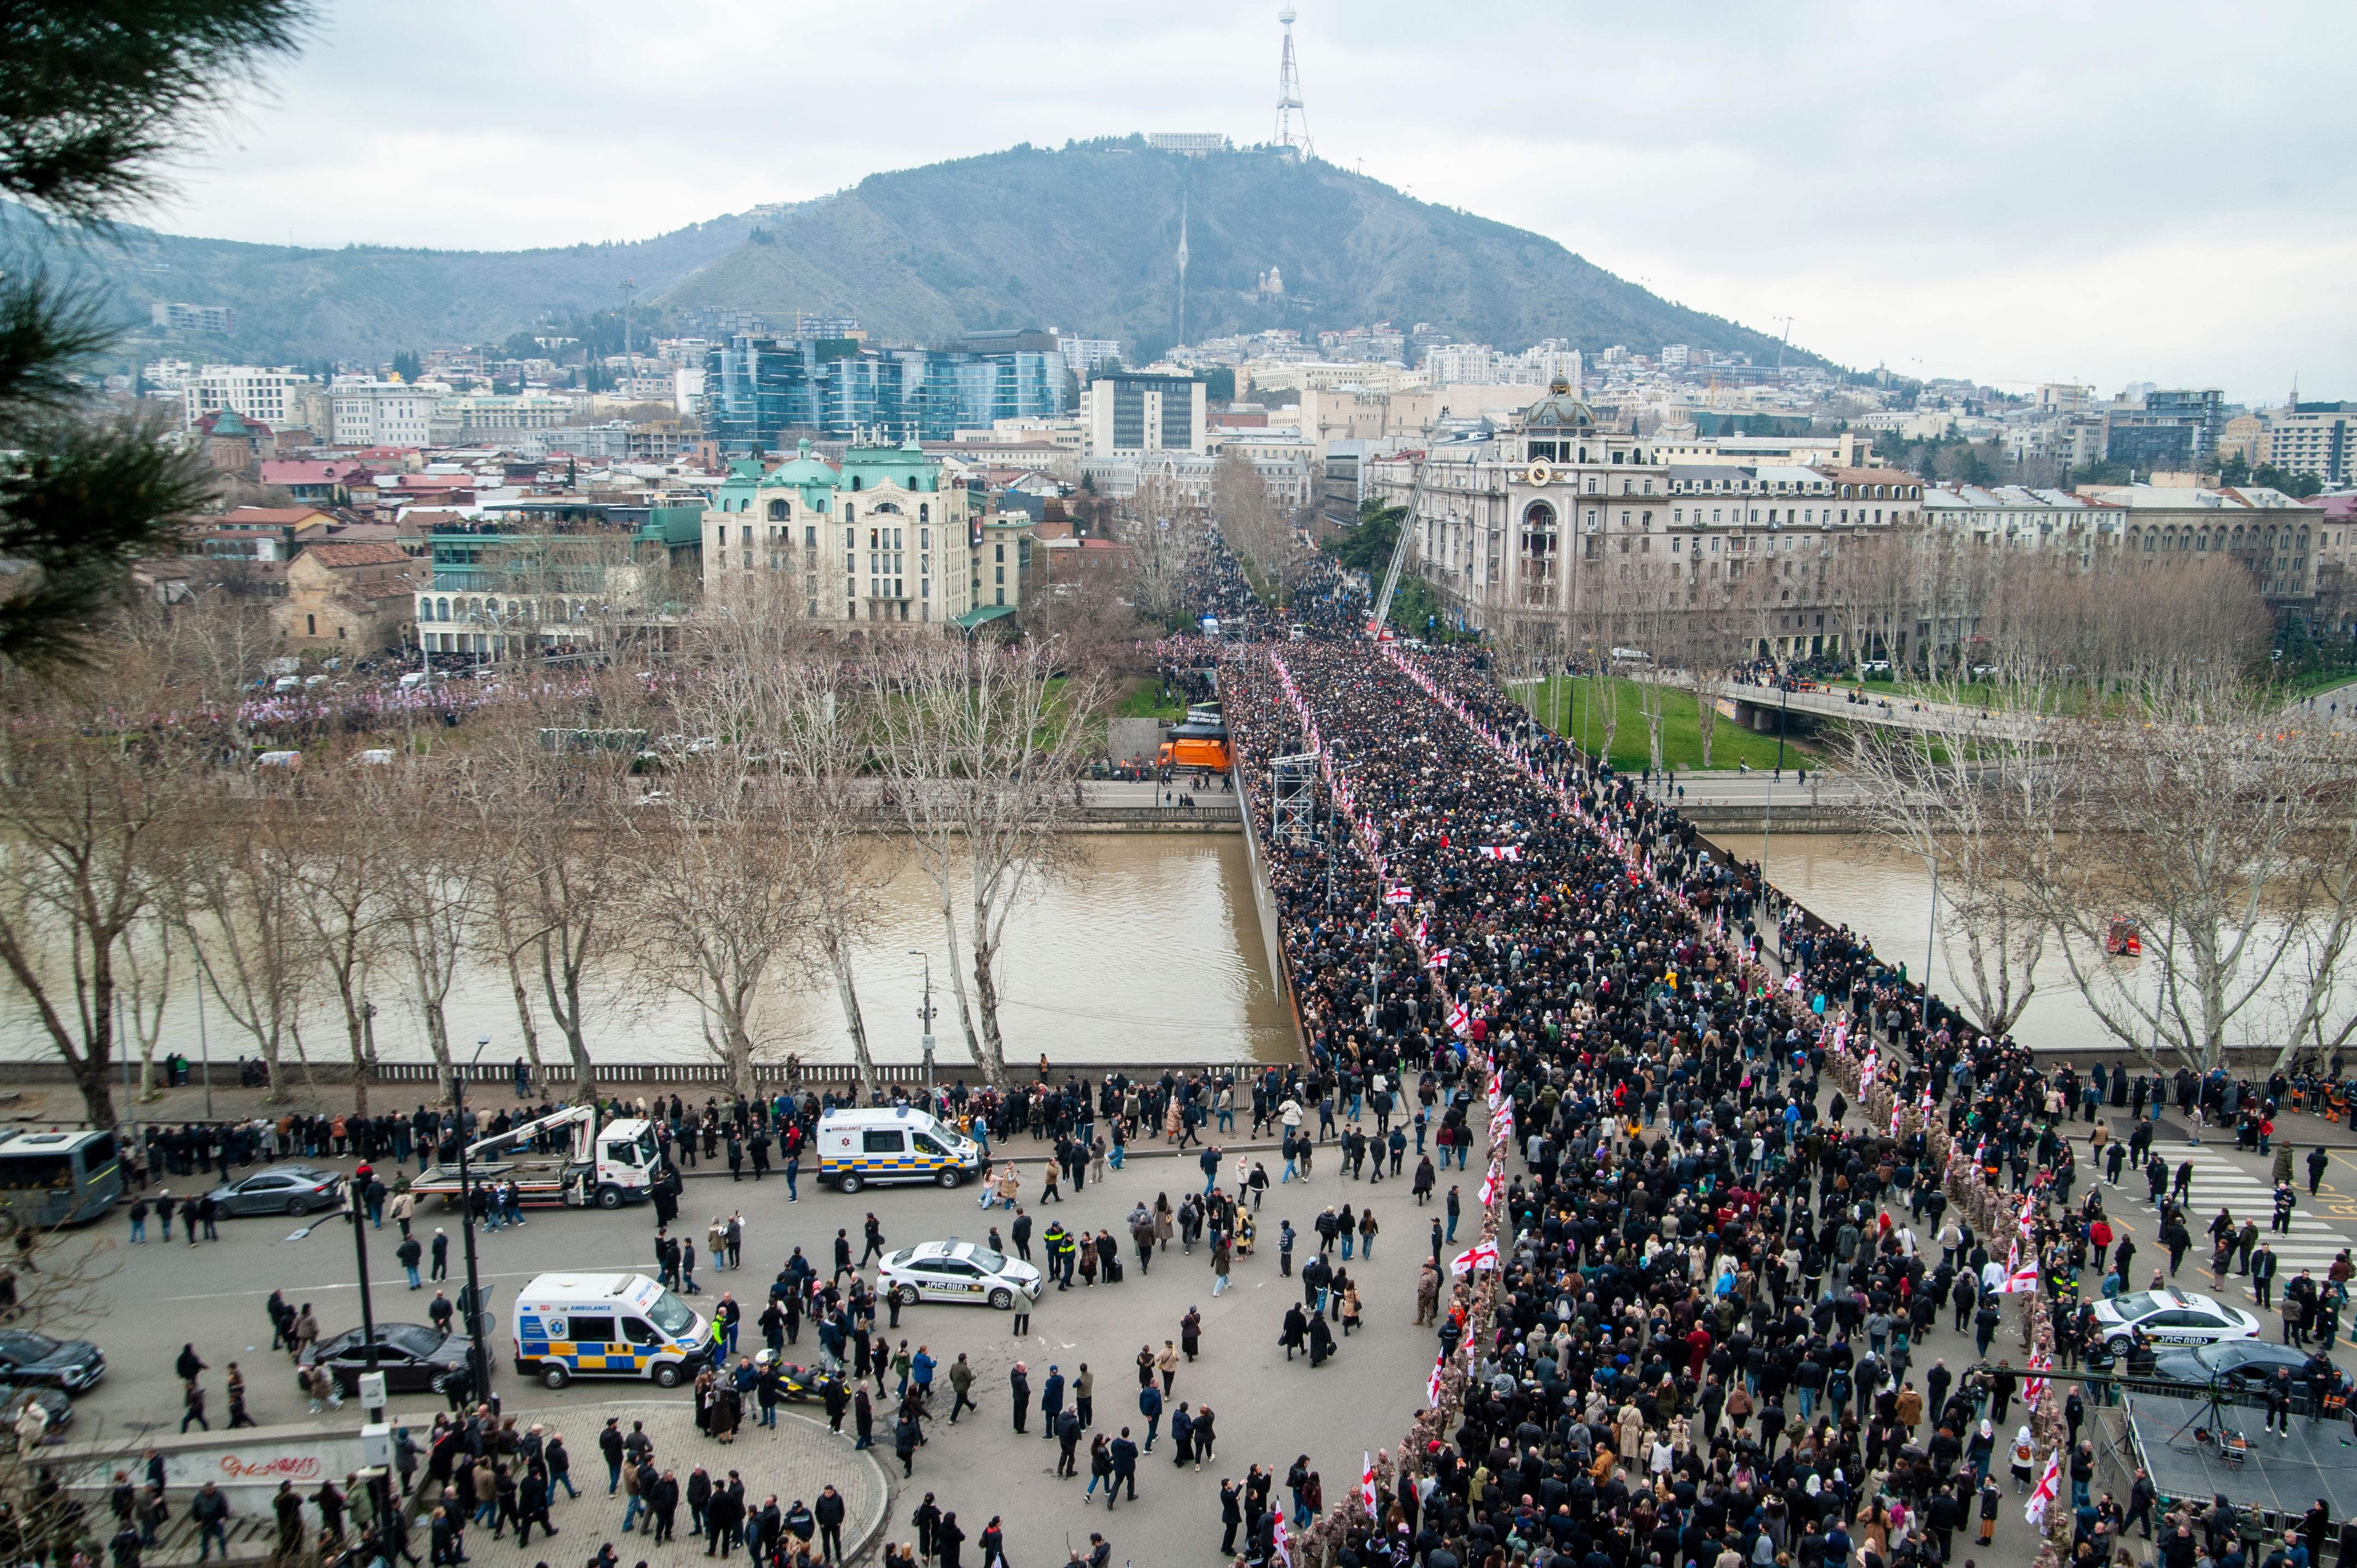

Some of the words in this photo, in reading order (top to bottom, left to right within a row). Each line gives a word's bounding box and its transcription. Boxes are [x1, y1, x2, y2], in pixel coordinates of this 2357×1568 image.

[867, 492, 908, 504] AMBASSADORI
[925, 1281, 968, 1292] პოლიცია
[2159, 1335, 2208, 1345] პოლიცია
